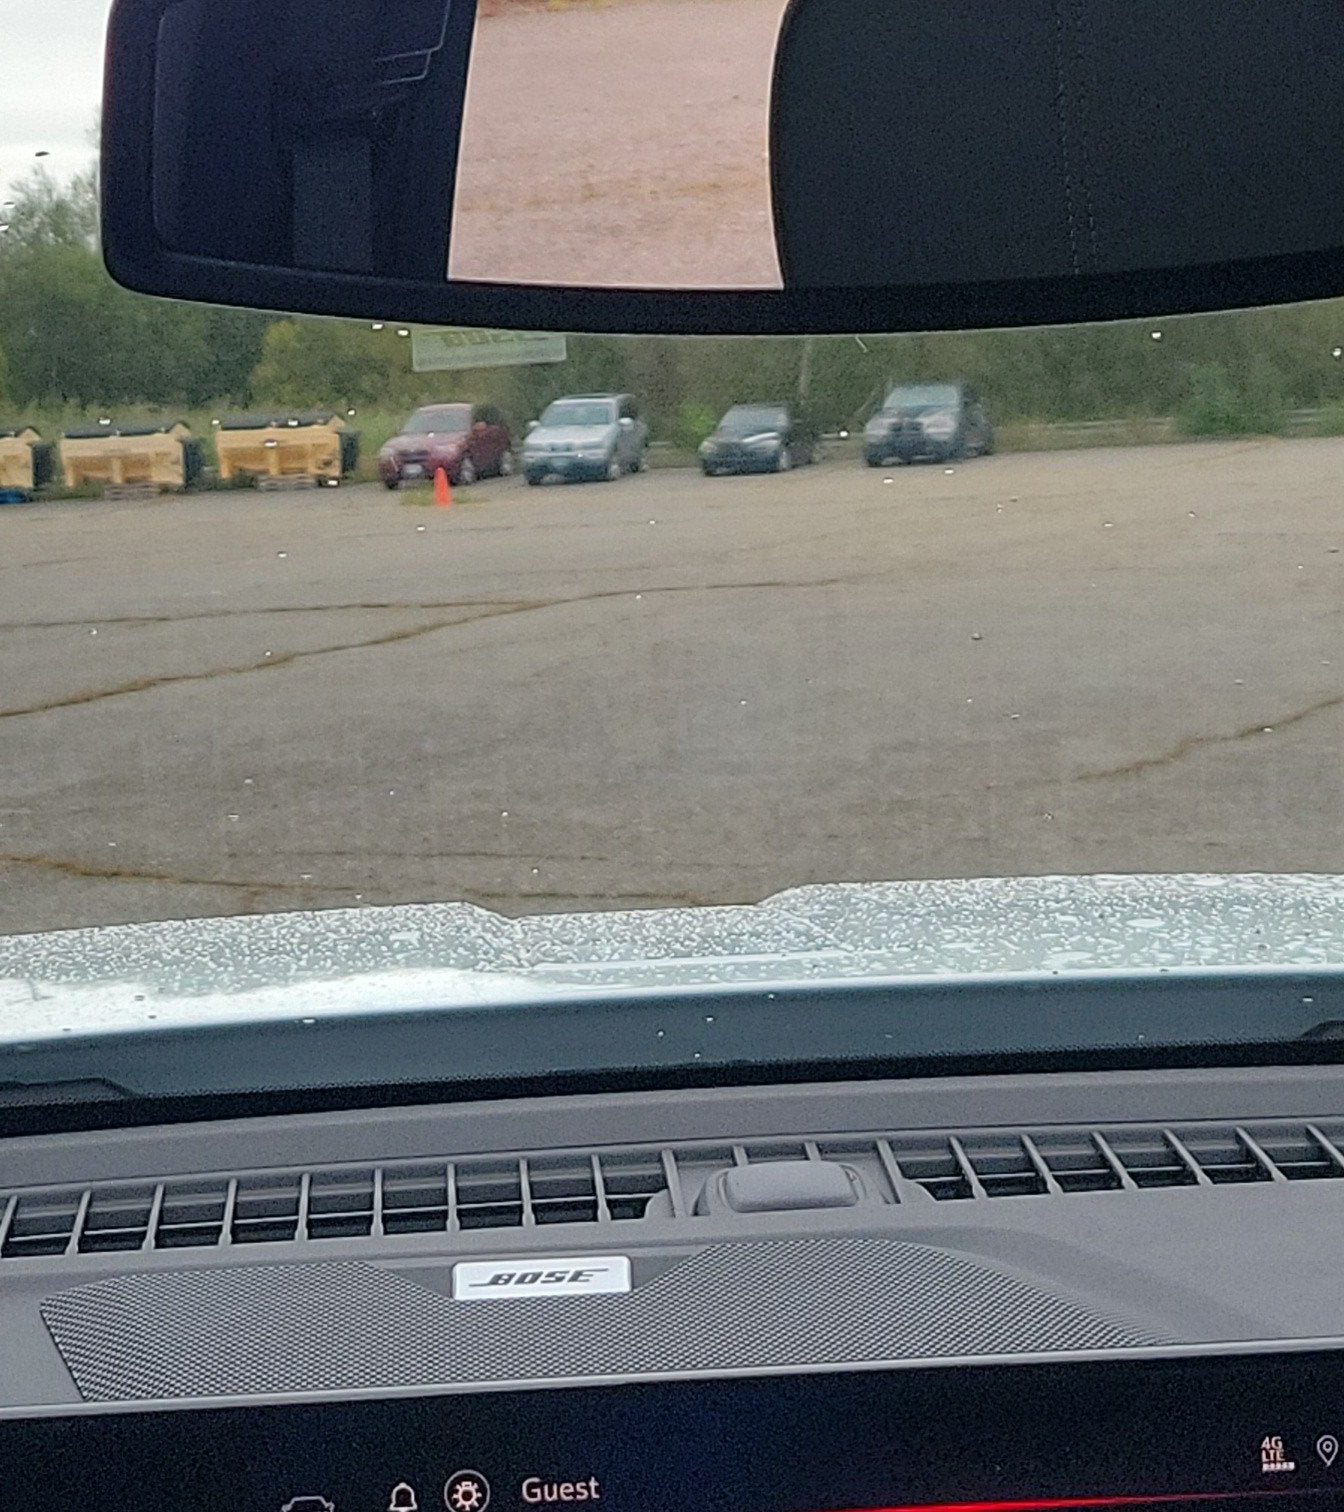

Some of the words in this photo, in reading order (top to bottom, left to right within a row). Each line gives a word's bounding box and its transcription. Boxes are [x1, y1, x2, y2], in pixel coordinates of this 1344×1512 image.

[468, 1268, 609, 1287] BOSE
[1260, 1436, 1283, 1449] 4G
[1261, 1448, 1286, 1462] LTE
[522, 1476, 600, 1503] Guest
